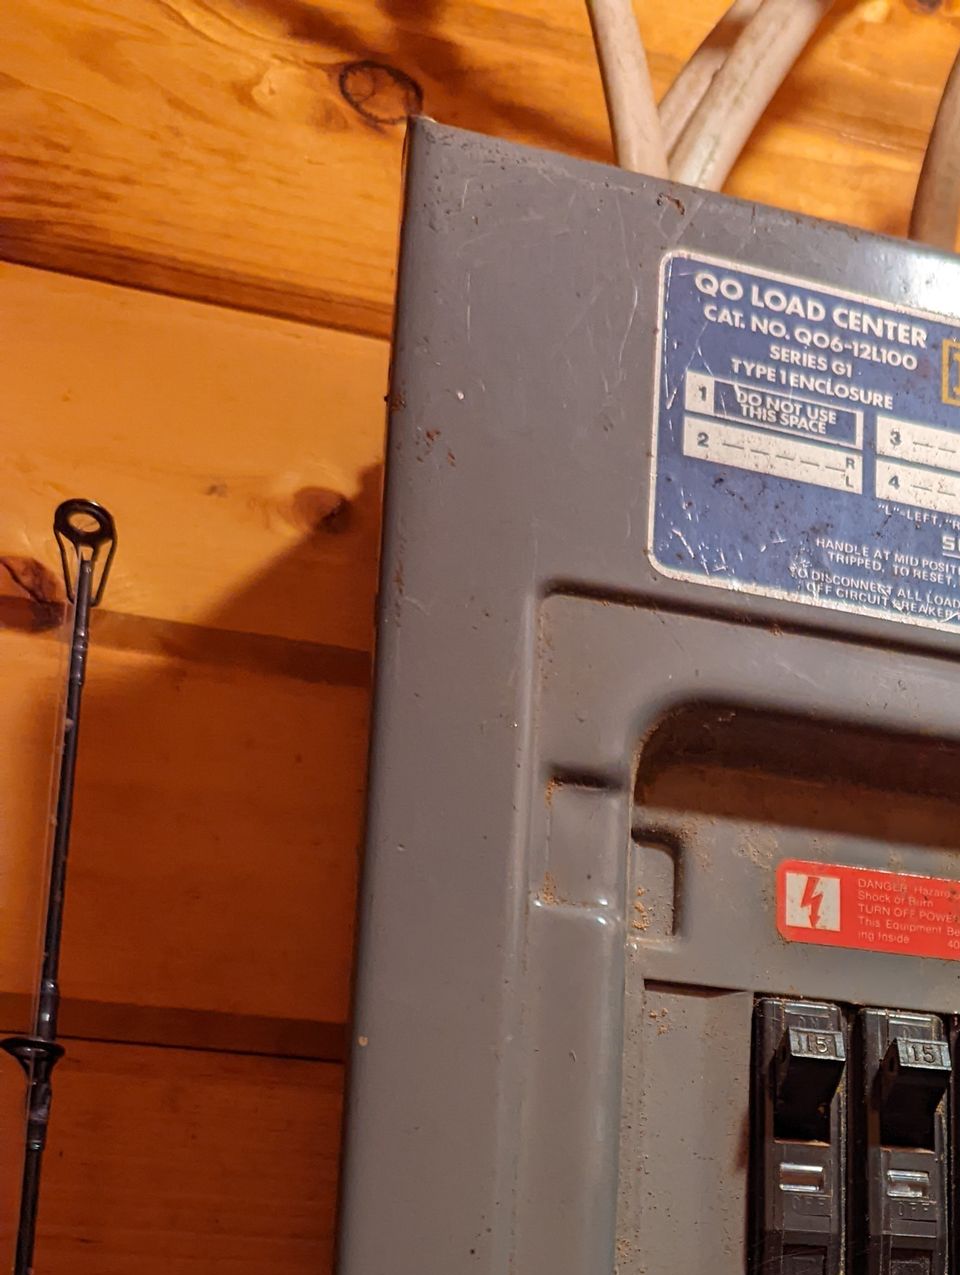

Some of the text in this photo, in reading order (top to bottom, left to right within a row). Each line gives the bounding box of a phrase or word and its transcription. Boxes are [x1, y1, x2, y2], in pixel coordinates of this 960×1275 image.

[695, 271, 926, 349] QO LOAD CENTER
[704, 303, 745, 329] CAT.
[751, 315, 789, 340] NO.
[770, 344, 852, 378] SERIES G1
[698, 385, 706, 400] 1
[731, 357, 776, 383] TYPE
[791, 371, 892, 410] ENCLOSURE
[737, 390, 836, 424] DO NOT USE
[741, 404, 826, 434] THIS SPACE
[697, 431, 708, 447] 2
[889, 429, 901, 446] 3
[845, 457, 854, 469] R
[845, 476, 853, 487] L
[888, 474, 899, 490] 4
[816, 537, 869, 557] HANDLE
[874, 548, 890, 561] AT
[894, 553, 918, 567] MID
[892, 564, 908, 576] TO
[811, 570, 891, 596] DISCONNECT
[897, 587, 921, 601] ALL
[926, 593, 960, 609] LOAD
[836, 587, 887, 606] CIRCUIT
[858, 891, 890, 903] Shock
[857, 903, 889, 916] TURN
[858, 916, 880, 927] This
[885, 919, 942, 937] Equipment
[911, 1044, 935, 1064] 15
